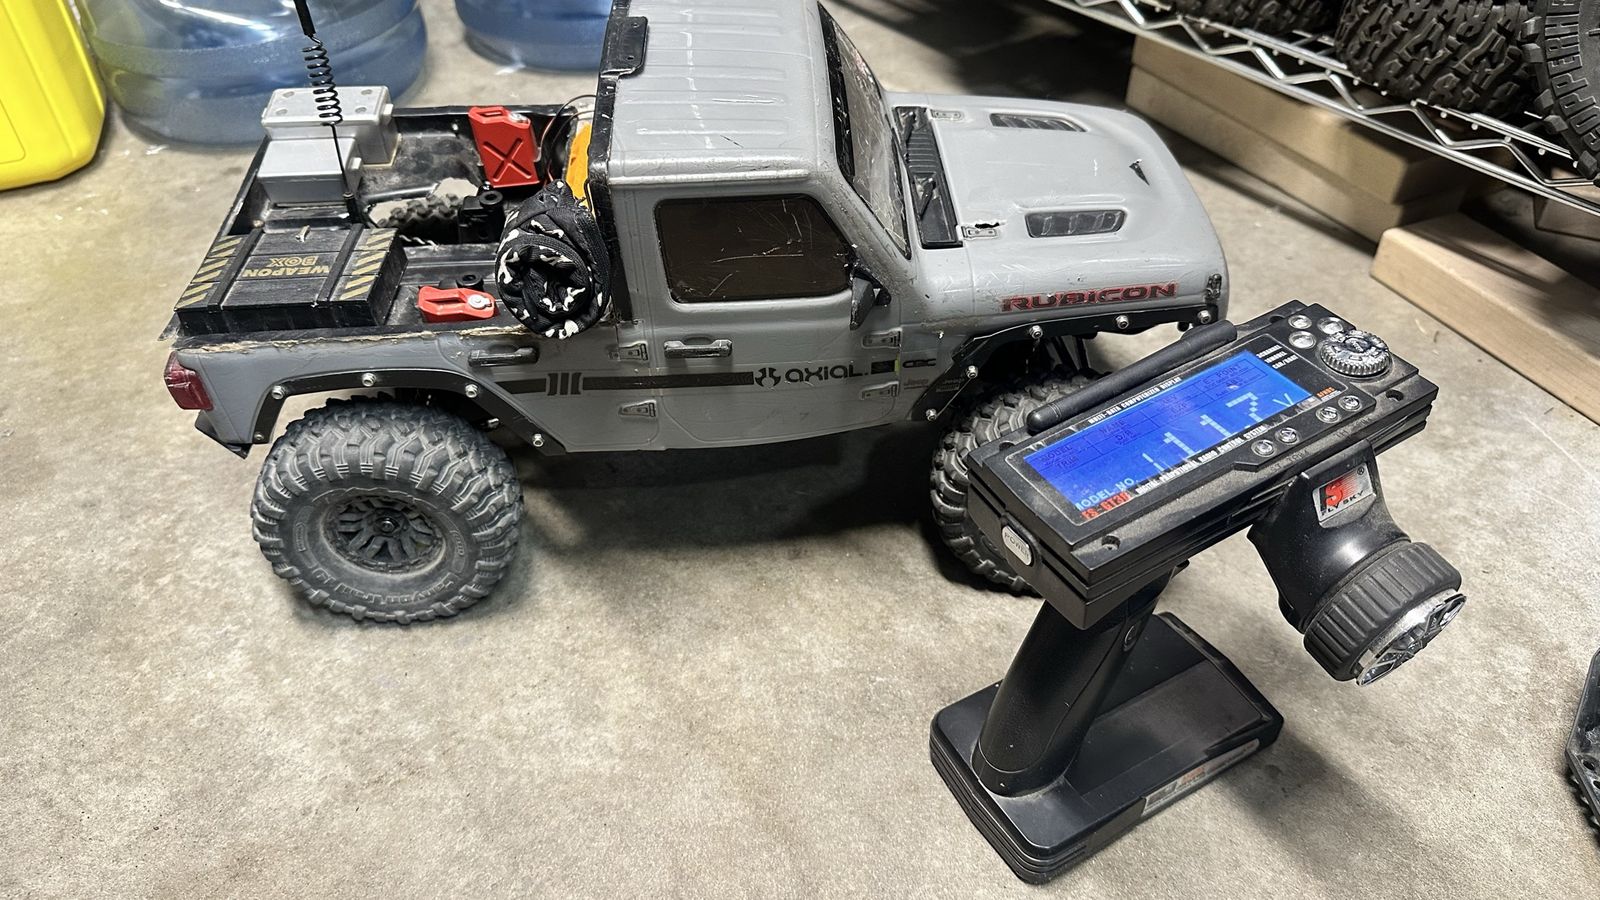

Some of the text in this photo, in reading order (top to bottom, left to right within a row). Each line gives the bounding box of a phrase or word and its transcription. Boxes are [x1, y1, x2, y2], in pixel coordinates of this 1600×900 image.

[266, 255, 318, 268] BOX
[242, 265, 330, 277] WEAPON
[1001, 281, 1178, 312] RUBICON
[1160, 377, 1182, 390] DISPLAY
[1199, 450, 1218, 463] RADIO
[1218, 436, 1244, 453] CONTROL
[1244, 424, 1268, 439] SYSTEM
